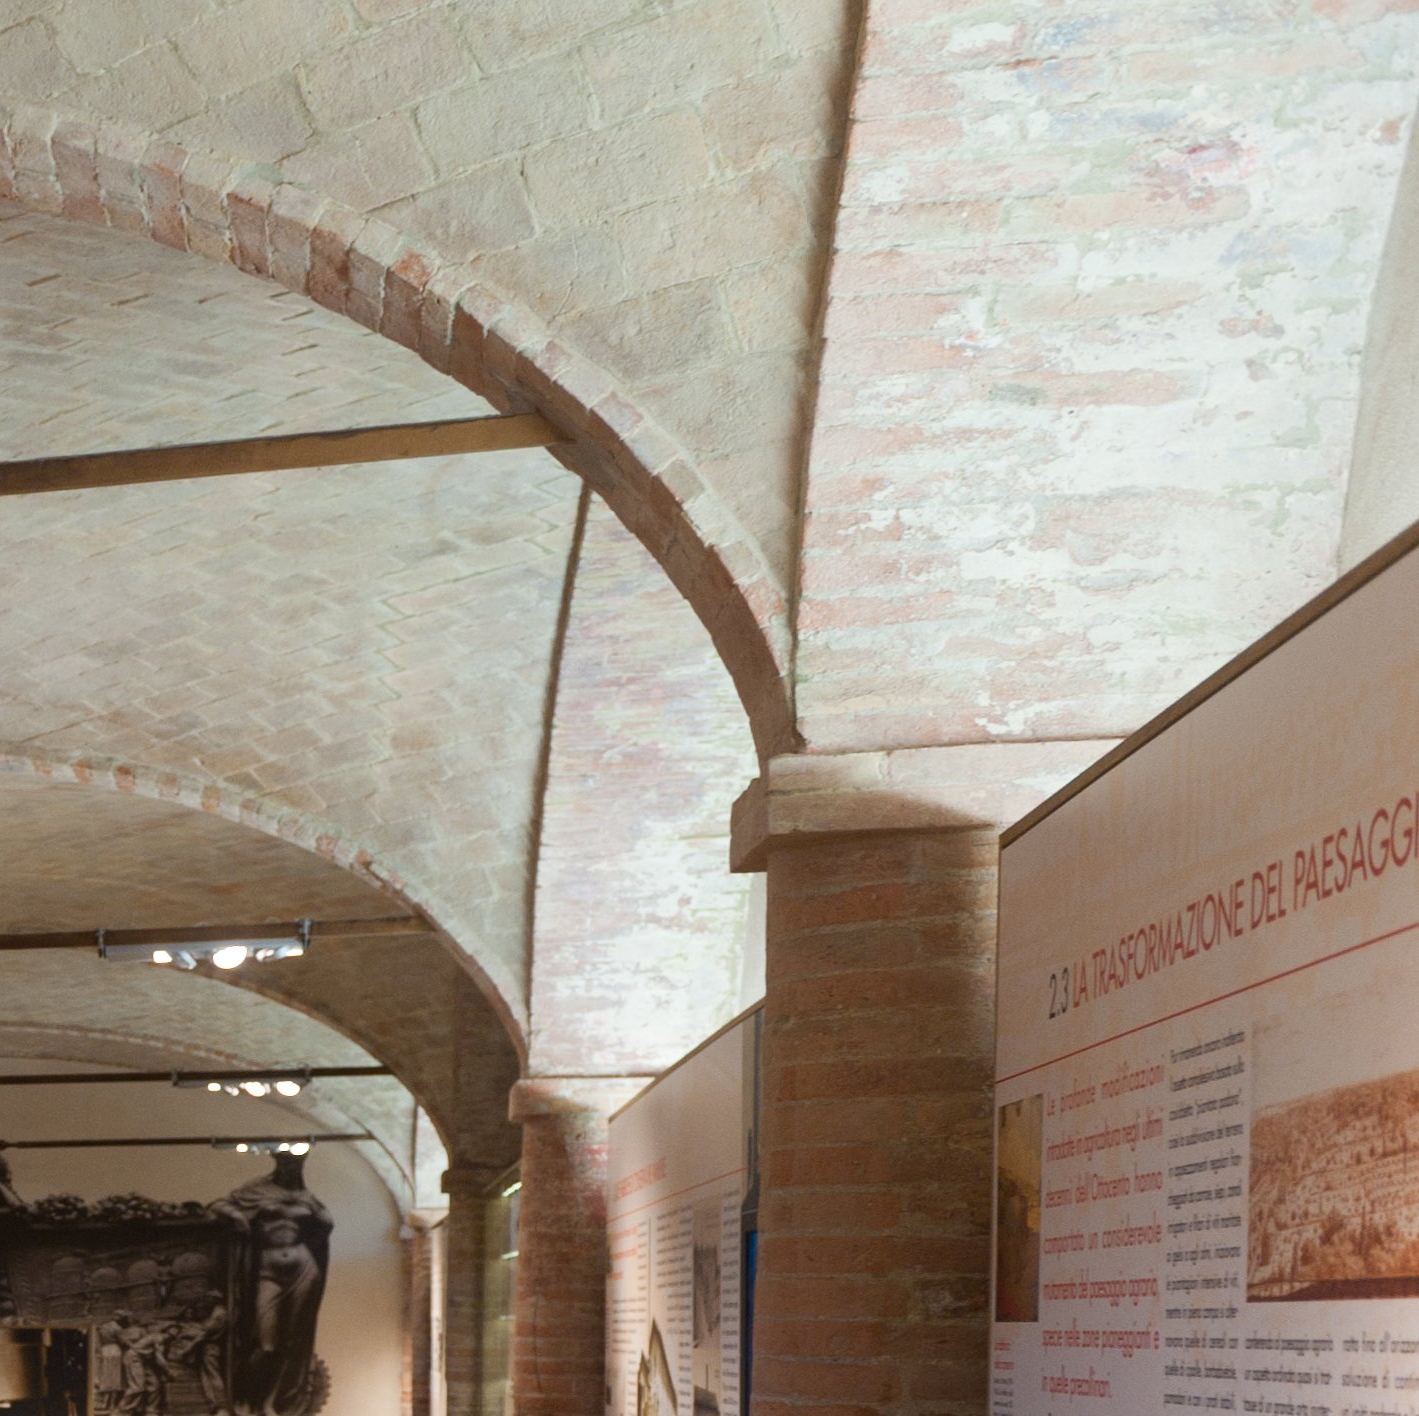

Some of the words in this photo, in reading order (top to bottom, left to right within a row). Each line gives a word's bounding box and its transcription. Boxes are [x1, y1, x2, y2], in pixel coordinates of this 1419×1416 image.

[1049, 966, 1069, 1019] 2.3
[1073, 959, 1089, 1009] LA
[1091, 879, 1245, 1000] TRASFORMAZIONE
[1251, 859, 1287, 931] DEL
